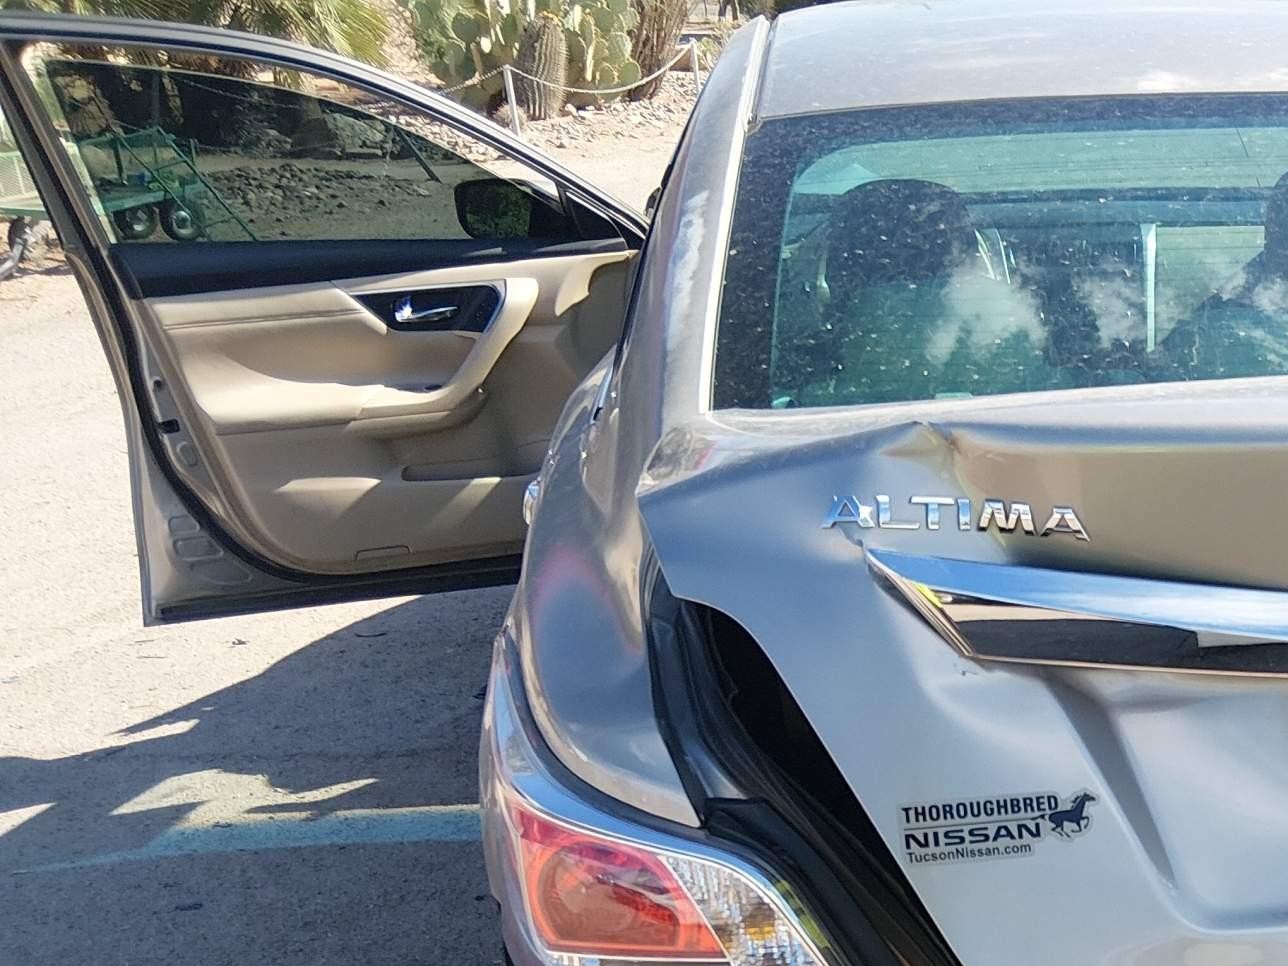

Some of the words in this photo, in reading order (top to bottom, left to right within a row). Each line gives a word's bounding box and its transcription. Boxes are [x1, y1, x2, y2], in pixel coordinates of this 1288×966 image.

[821, 494, 1090, 541] ALTIMA
[902, 795, 1058, 823] THOROUGHBRED
[904, 822, 1041, 850] NISSAN
[907, 843, 1031, 864] TucsonNissan.com
